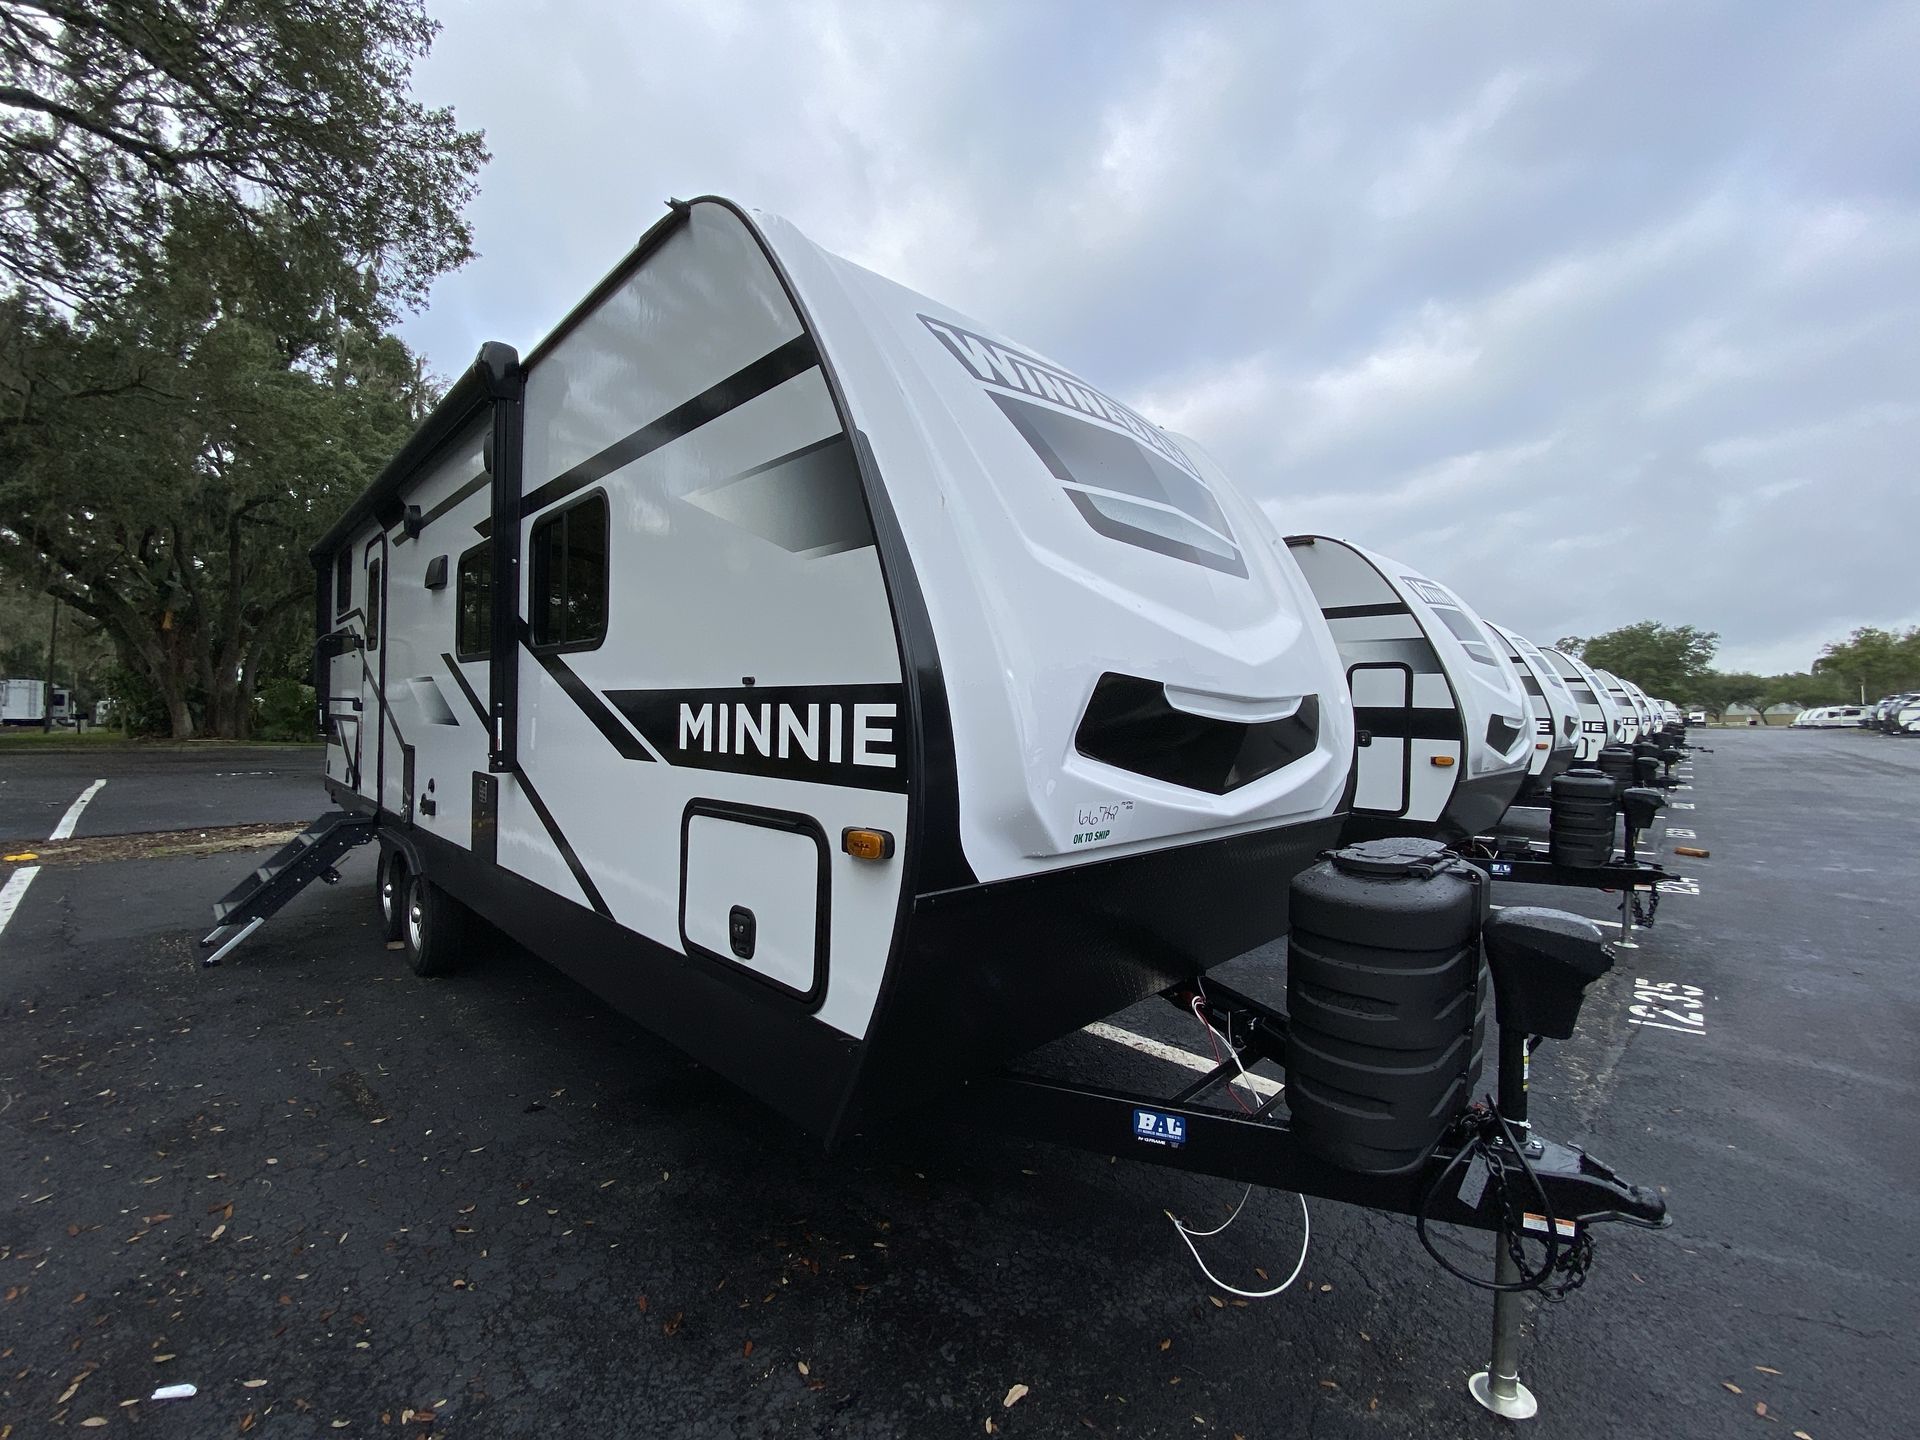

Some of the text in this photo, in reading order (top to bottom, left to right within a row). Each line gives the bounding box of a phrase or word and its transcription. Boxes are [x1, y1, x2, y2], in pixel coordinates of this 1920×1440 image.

[679, 703, 897, 768] MINNIE
[1073, 829, 1111, 844] OK TO SHIP
[1628, 977, 1706, 1036] 1235
